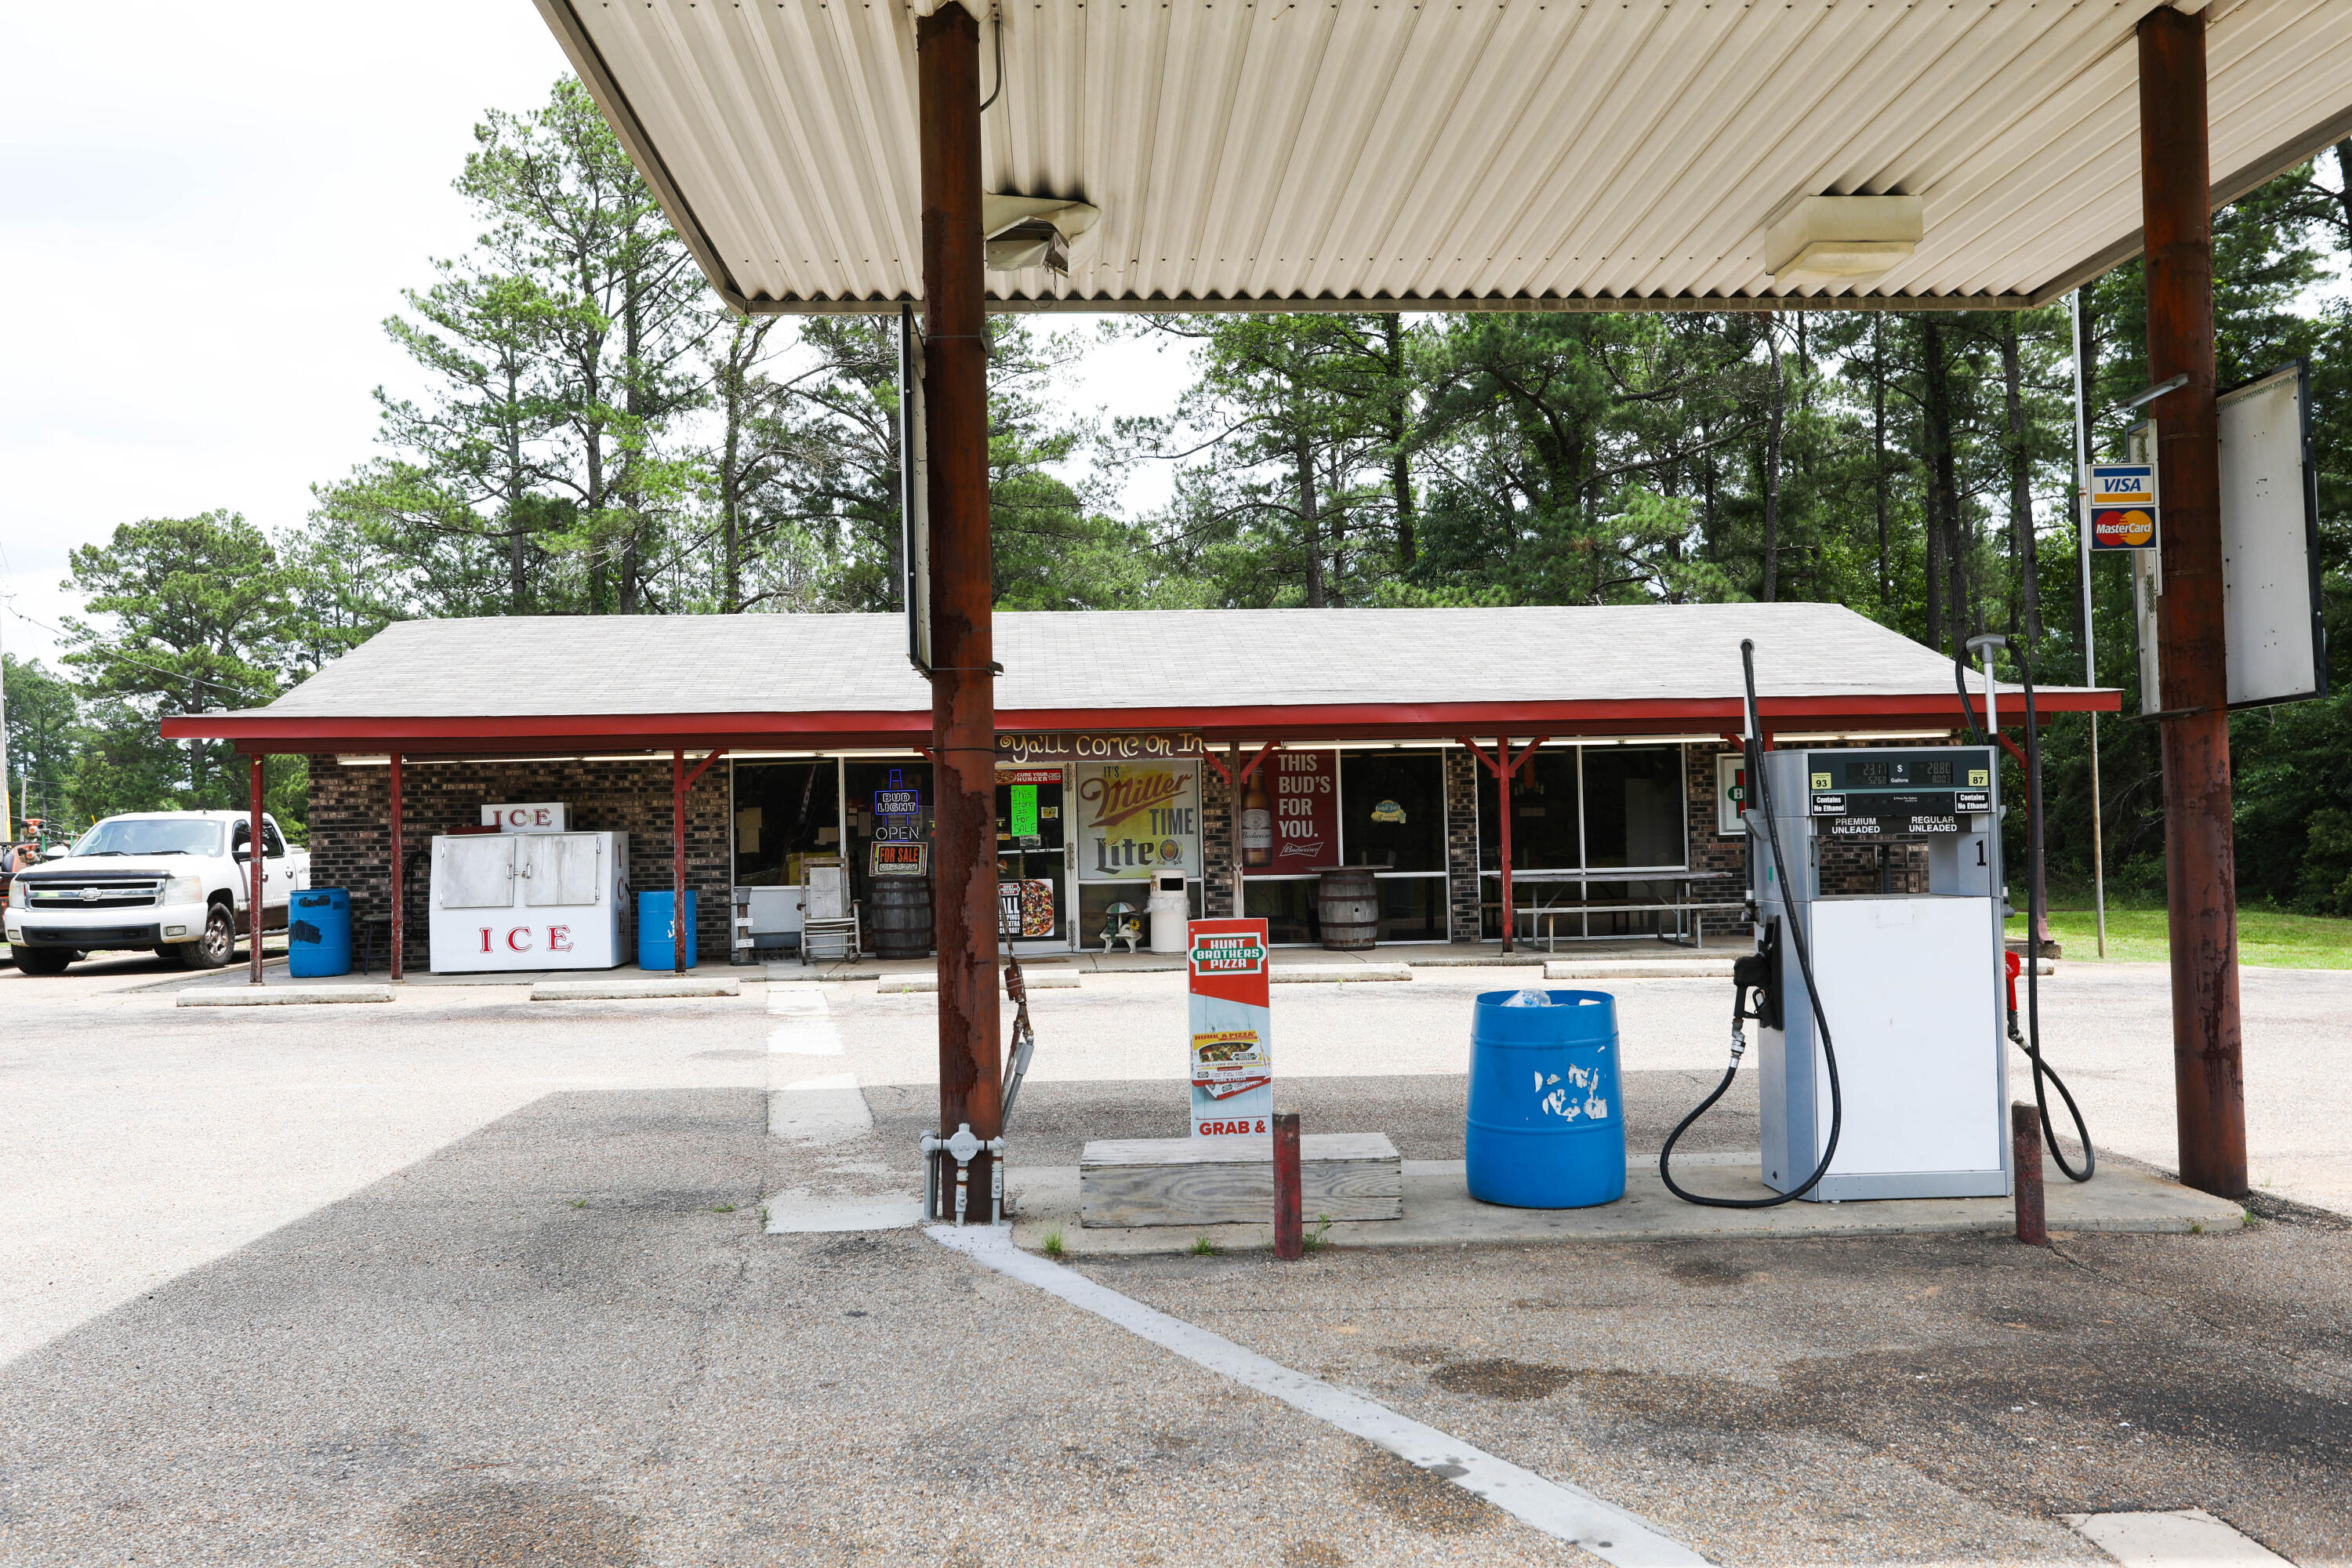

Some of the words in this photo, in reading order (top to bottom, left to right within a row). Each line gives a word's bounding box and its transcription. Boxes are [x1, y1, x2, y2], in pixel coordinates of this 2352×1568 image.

[2103, 477, 2141, 492] VISA
[2096, 523, 2151, 534] MasterCard
[1145, 735, 1173, 756] On
[1178, 733, 1203, 753] In
[1278, 753, 1317, 771] THIS
[1103, 766, 1120, 778] IT'S
[1279, 775, 1331, 793] BUD'S
[883, 793, 910, 802] BUD
[1011, 789, 1033, 799] This
[1080, 773, 1193, 818] Miller
[877, 803, 916, 811] LIGHT
[1012, 800, 1034, 808] Store
[1279, 798, 1312, 815] FOR
[493, 808, 553, 828] ICE
[1911, 815, 1955, 824] REGULAR
[876, 826, 919, 840] OPEN
[1013, 822, 1036, 833] SALE
[1278, 820, 1319, 838] YOU.
[1831, 826, 1880, 834] UNLEADED
[1908, 824, 1958, 833] UNLEADED
[880, 848, 895, 863] FOR
[898, 848, 918, 862] SALE
[1094, 837, 1155, 874] Lite
[1976, 840, 1987, 866] 1
[479, 925, 574, 953] ICE
[1210, 938, 1245, 949] HUNT
[1196, 949, 1259, 960] BROTHERS
[1210, 958, 1247, 969] PIZZA
[1199, 1121, 1250, 1135] GRAB
[1254, 1120, 1266, 1134] &
